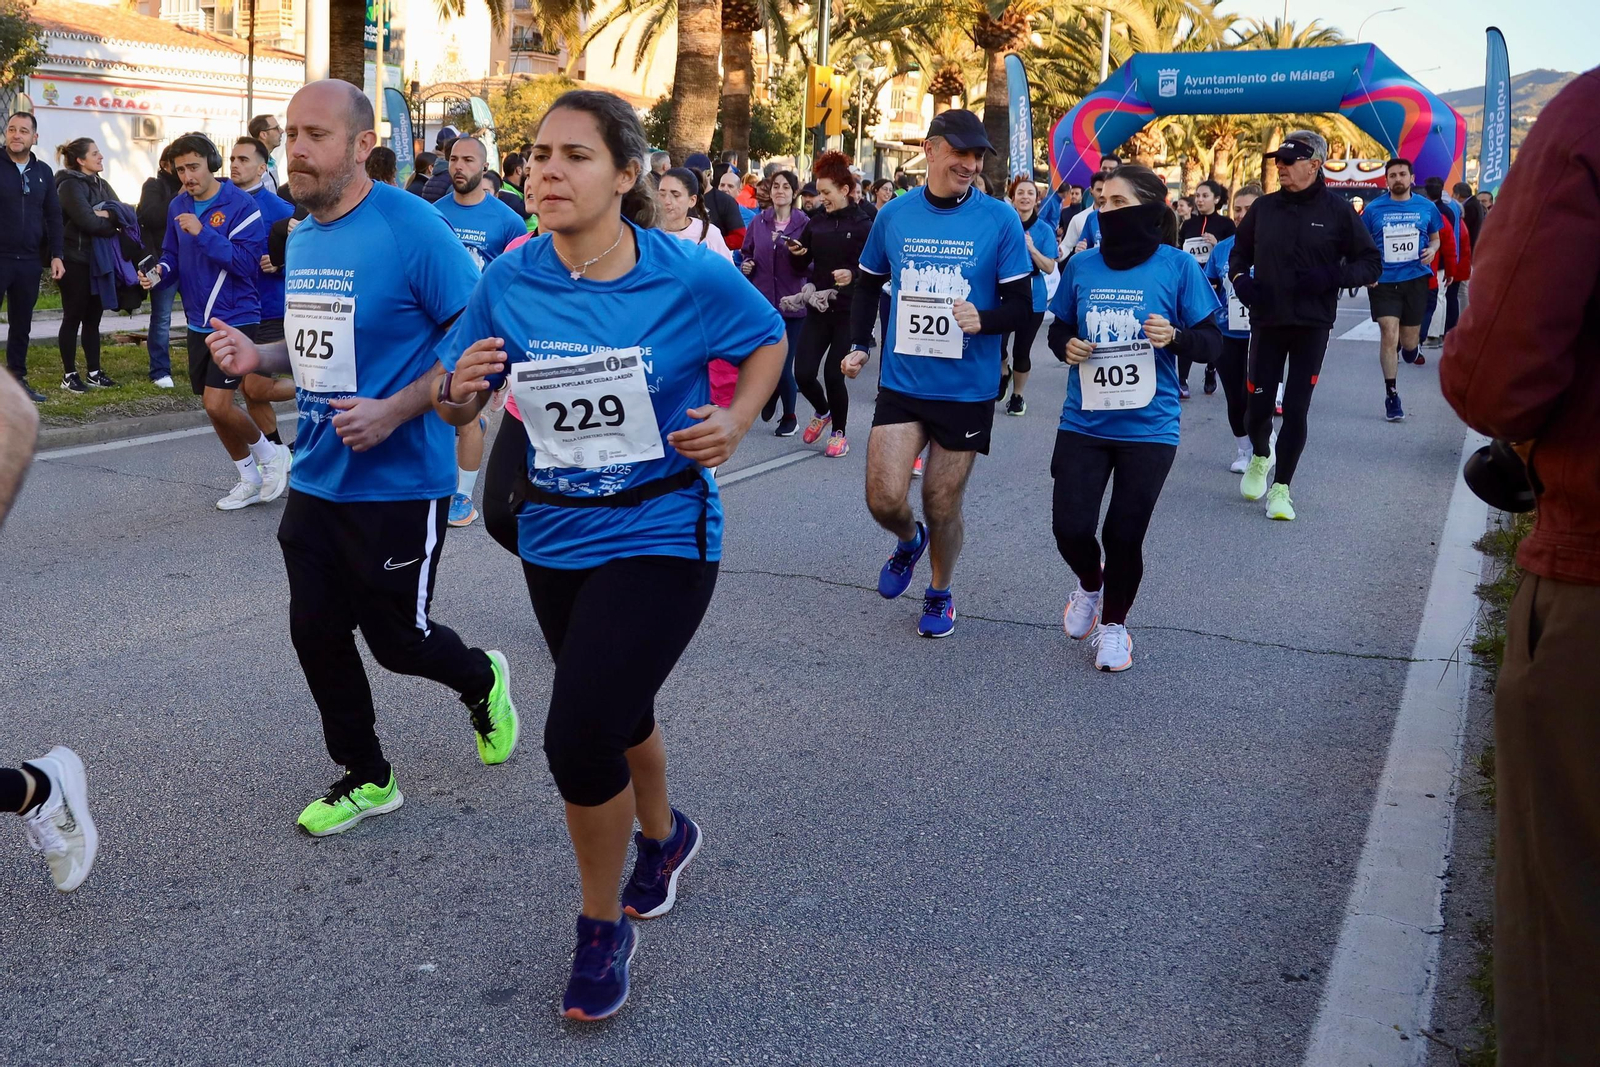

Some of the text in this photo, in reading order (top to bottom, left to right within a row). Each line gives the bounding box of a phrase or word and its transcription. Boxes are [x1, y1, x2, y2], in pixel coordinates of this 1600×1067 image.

[1184, 69, 1335, 87] Ayuntamiento de Málaga
[1184, 86, 1244, 96] Área de Deporte
[73, 95, 162, 111] SAGRADA
[903, 244, 974, 256] CIUDAD JARDÍN
[1190, 246, 1208, 256] 410
[1392, 242, 1414, 252] 540
[295, 268, 317, 276] CARRERA
[318, 269, 344, 277] URBANA
[344, 270, 354, 278] DE
[288, 276, 353, 292] CIUDAD JARDÍN
[1116, 294, 1143, 302] JARDÍN
[909, 314, 950, 336] 520
[295, 329, 334, 360] 425
[528, 340, 539, 349] VII
[540, 340, 588, 353] CARRERA
[1094, 364, 1140, 387] 403
[545, 394, 625, 432] 229
[602, 464, 632, 475] 2025
